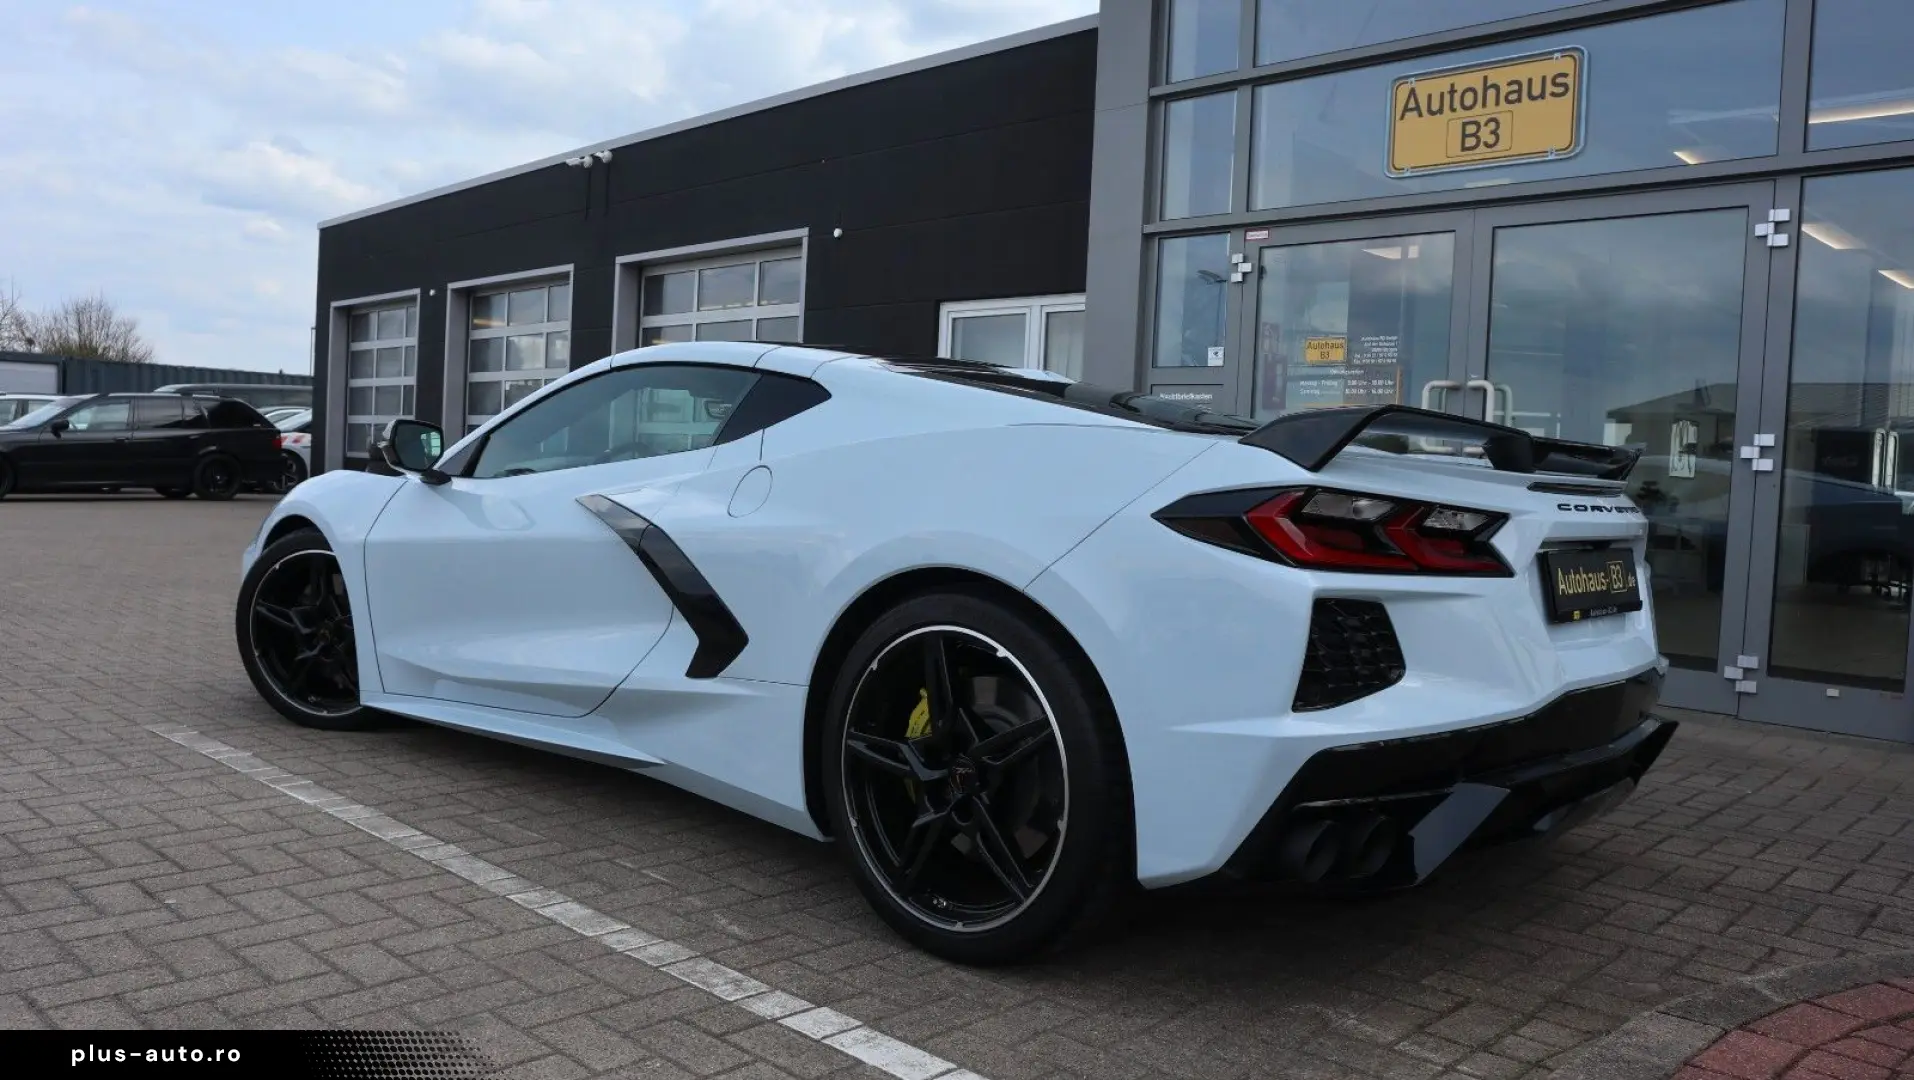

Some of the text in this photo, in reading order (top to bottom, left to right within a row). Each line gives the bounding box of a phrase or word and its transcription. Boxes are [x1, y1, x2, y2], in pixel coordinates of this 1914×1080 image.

[1399, 72, 1570, 121] Autohaus
[1460, 117, 1501, 152] B3
[1305, 341, 1344, 350] Autohaus
[1320, 351, 1330, 359] B3
